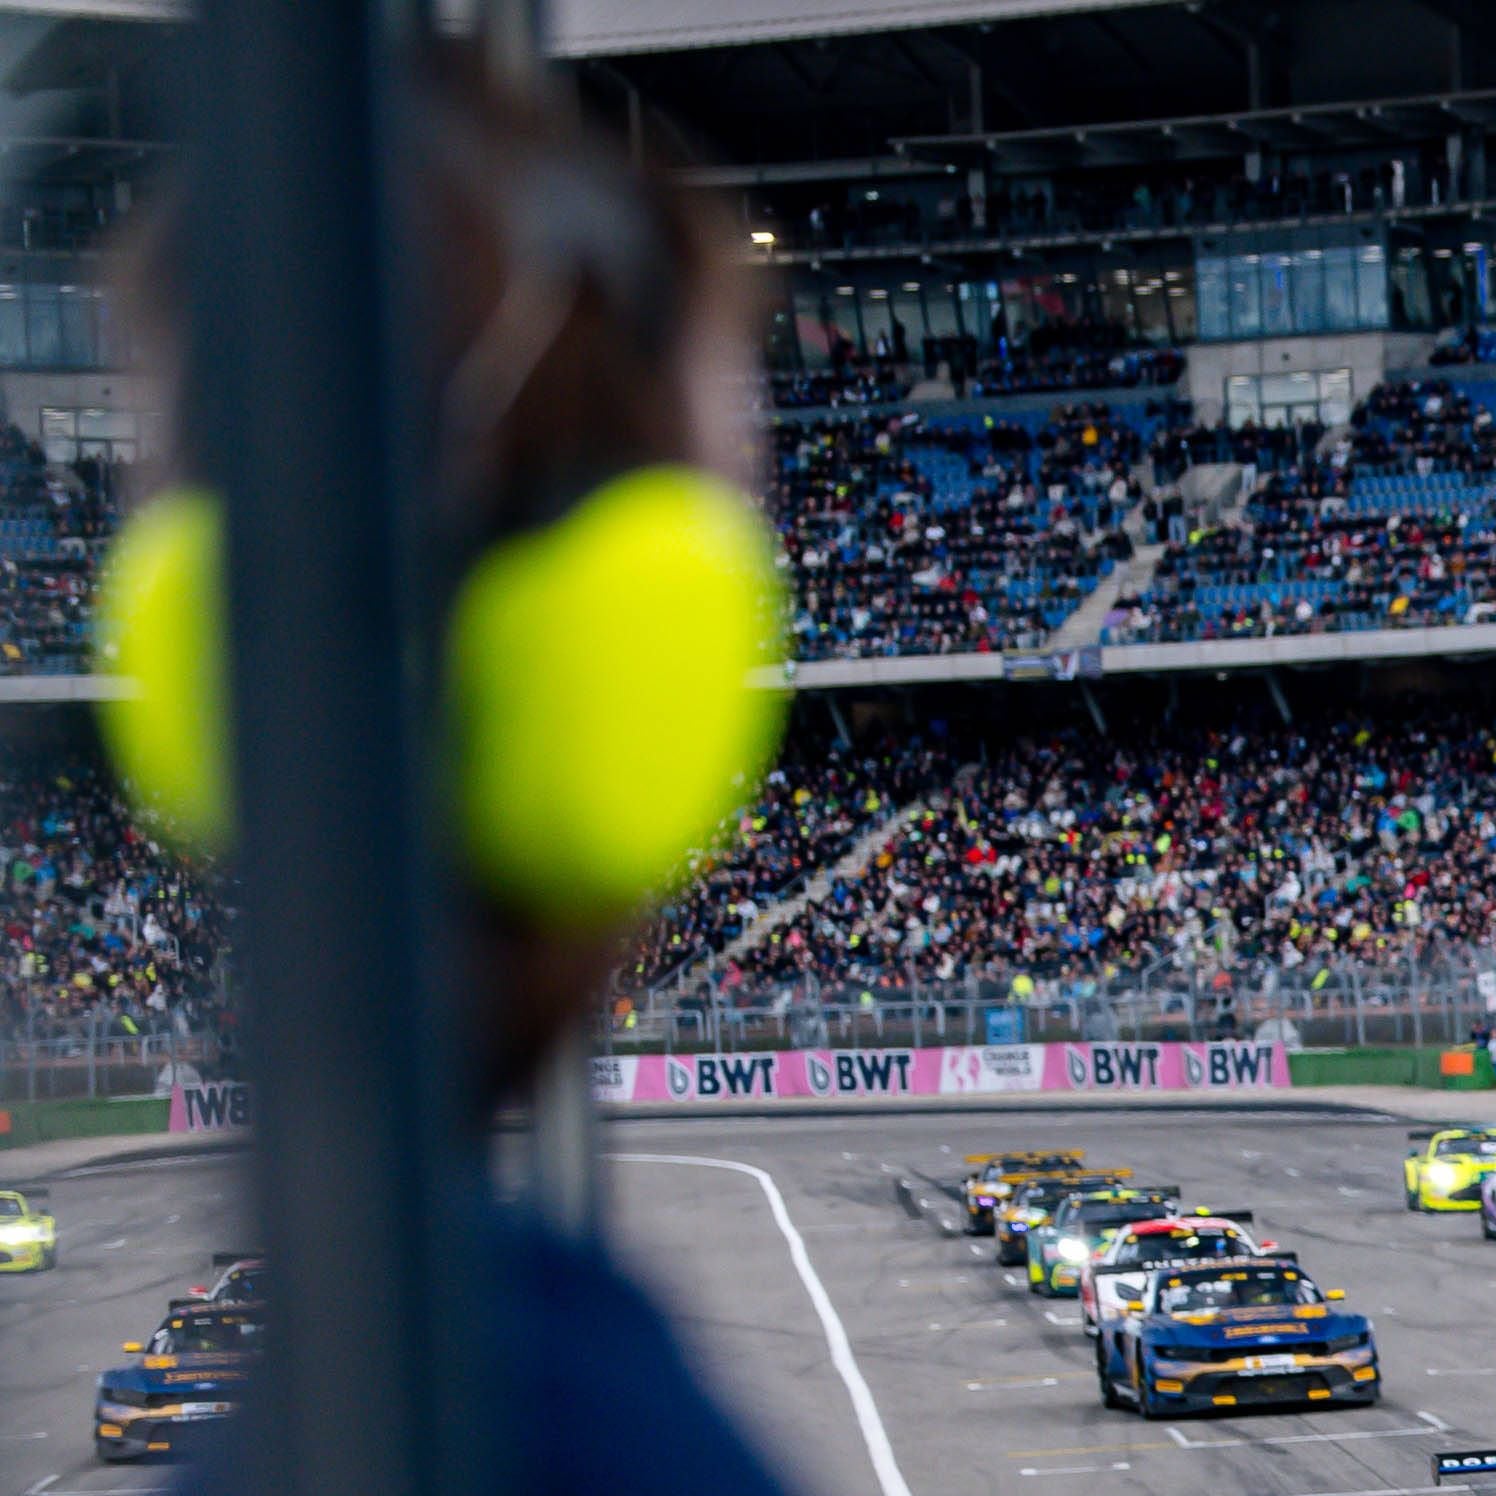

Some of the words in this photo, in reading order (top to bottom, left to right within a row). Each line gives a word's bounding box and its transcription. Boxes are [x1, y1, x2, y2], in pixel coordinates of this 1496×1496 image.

[698, 1056, 775, 1095] BWT
[837, 1055, 911, 1093] BWT
[1092, 1046, 1160, 1085] BWT
[1210, 1045, 1272, 1085] BWT
